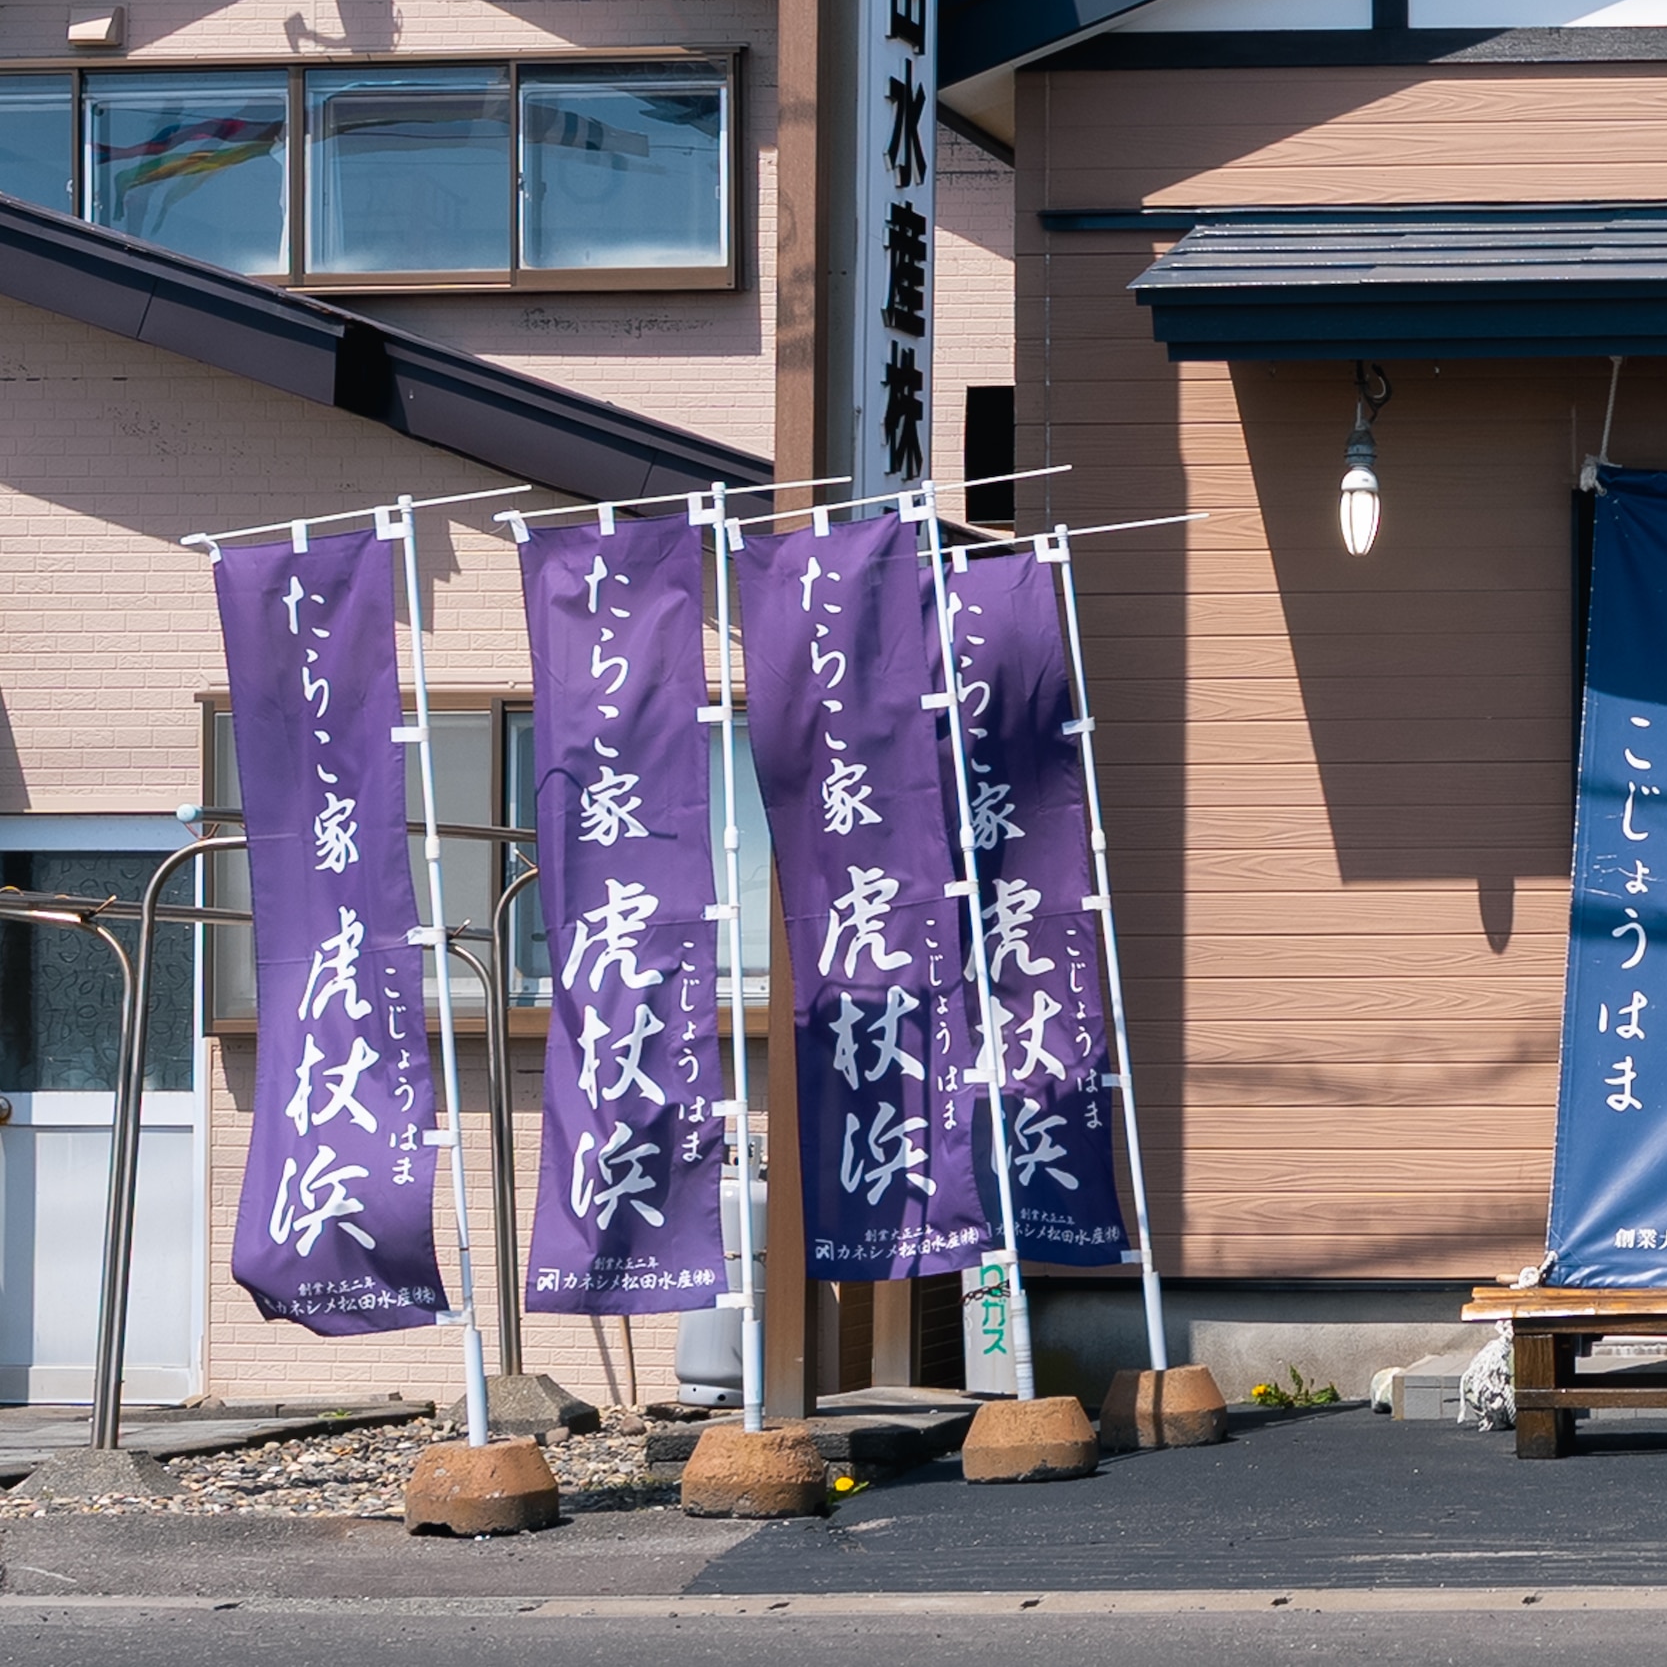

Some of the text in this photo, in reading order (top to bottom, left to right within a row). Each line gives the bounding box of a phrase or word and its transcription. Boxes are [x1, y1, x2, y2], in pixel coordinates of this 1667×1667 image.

[269, 576, 379, 1258] たらこ家 虎杖浜
[561, 555, 667, 1230] たらこ家 虎杖浜
[800, 555, 936, 1206] たらこ家 虎杖浜
[923, 920, 959, 1131] こじょうはま
[946, 592, 1078, 1192] たらこ家 虎杖浜
[1064, 928, 1103, 1131] こじょうはま
[1599, 716, 1662, 1112] こじょうはま
[384, 968, 416, 1186] こじょうはま
[677, 940, 706, 1162] こじょうはま
[298, 1276, 376, 1297] 創業大正二年
